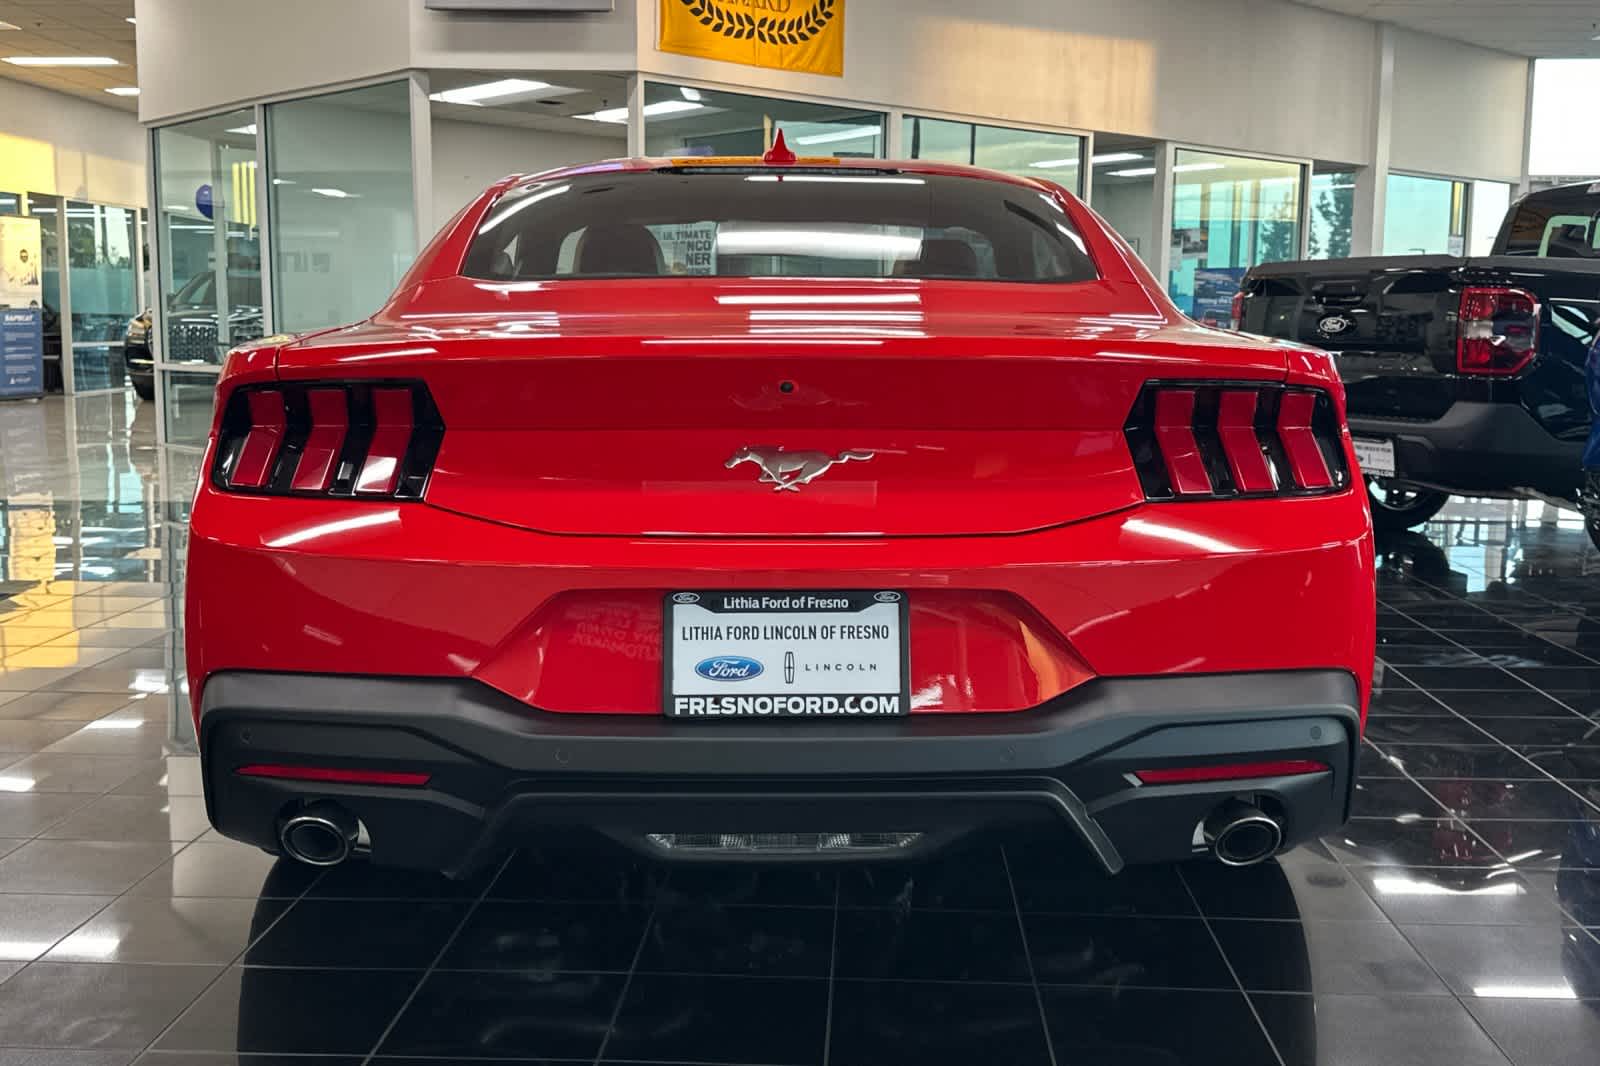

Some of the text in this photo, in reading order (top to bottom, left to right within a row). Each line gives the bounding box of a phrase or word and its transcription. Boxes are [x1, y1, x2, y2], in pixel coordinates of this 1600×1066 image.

[723, 596, 849, 609] Lithia Ford of Fresno
[682, 625, 889, 641] LITHIA FORD LINCOLN OF FRESNO
[708, 659, 750, 677] Ford
[805, 663, 877, 672] LINCOLN
[674, 696, 899, 715] FRESNOFORD.COM
